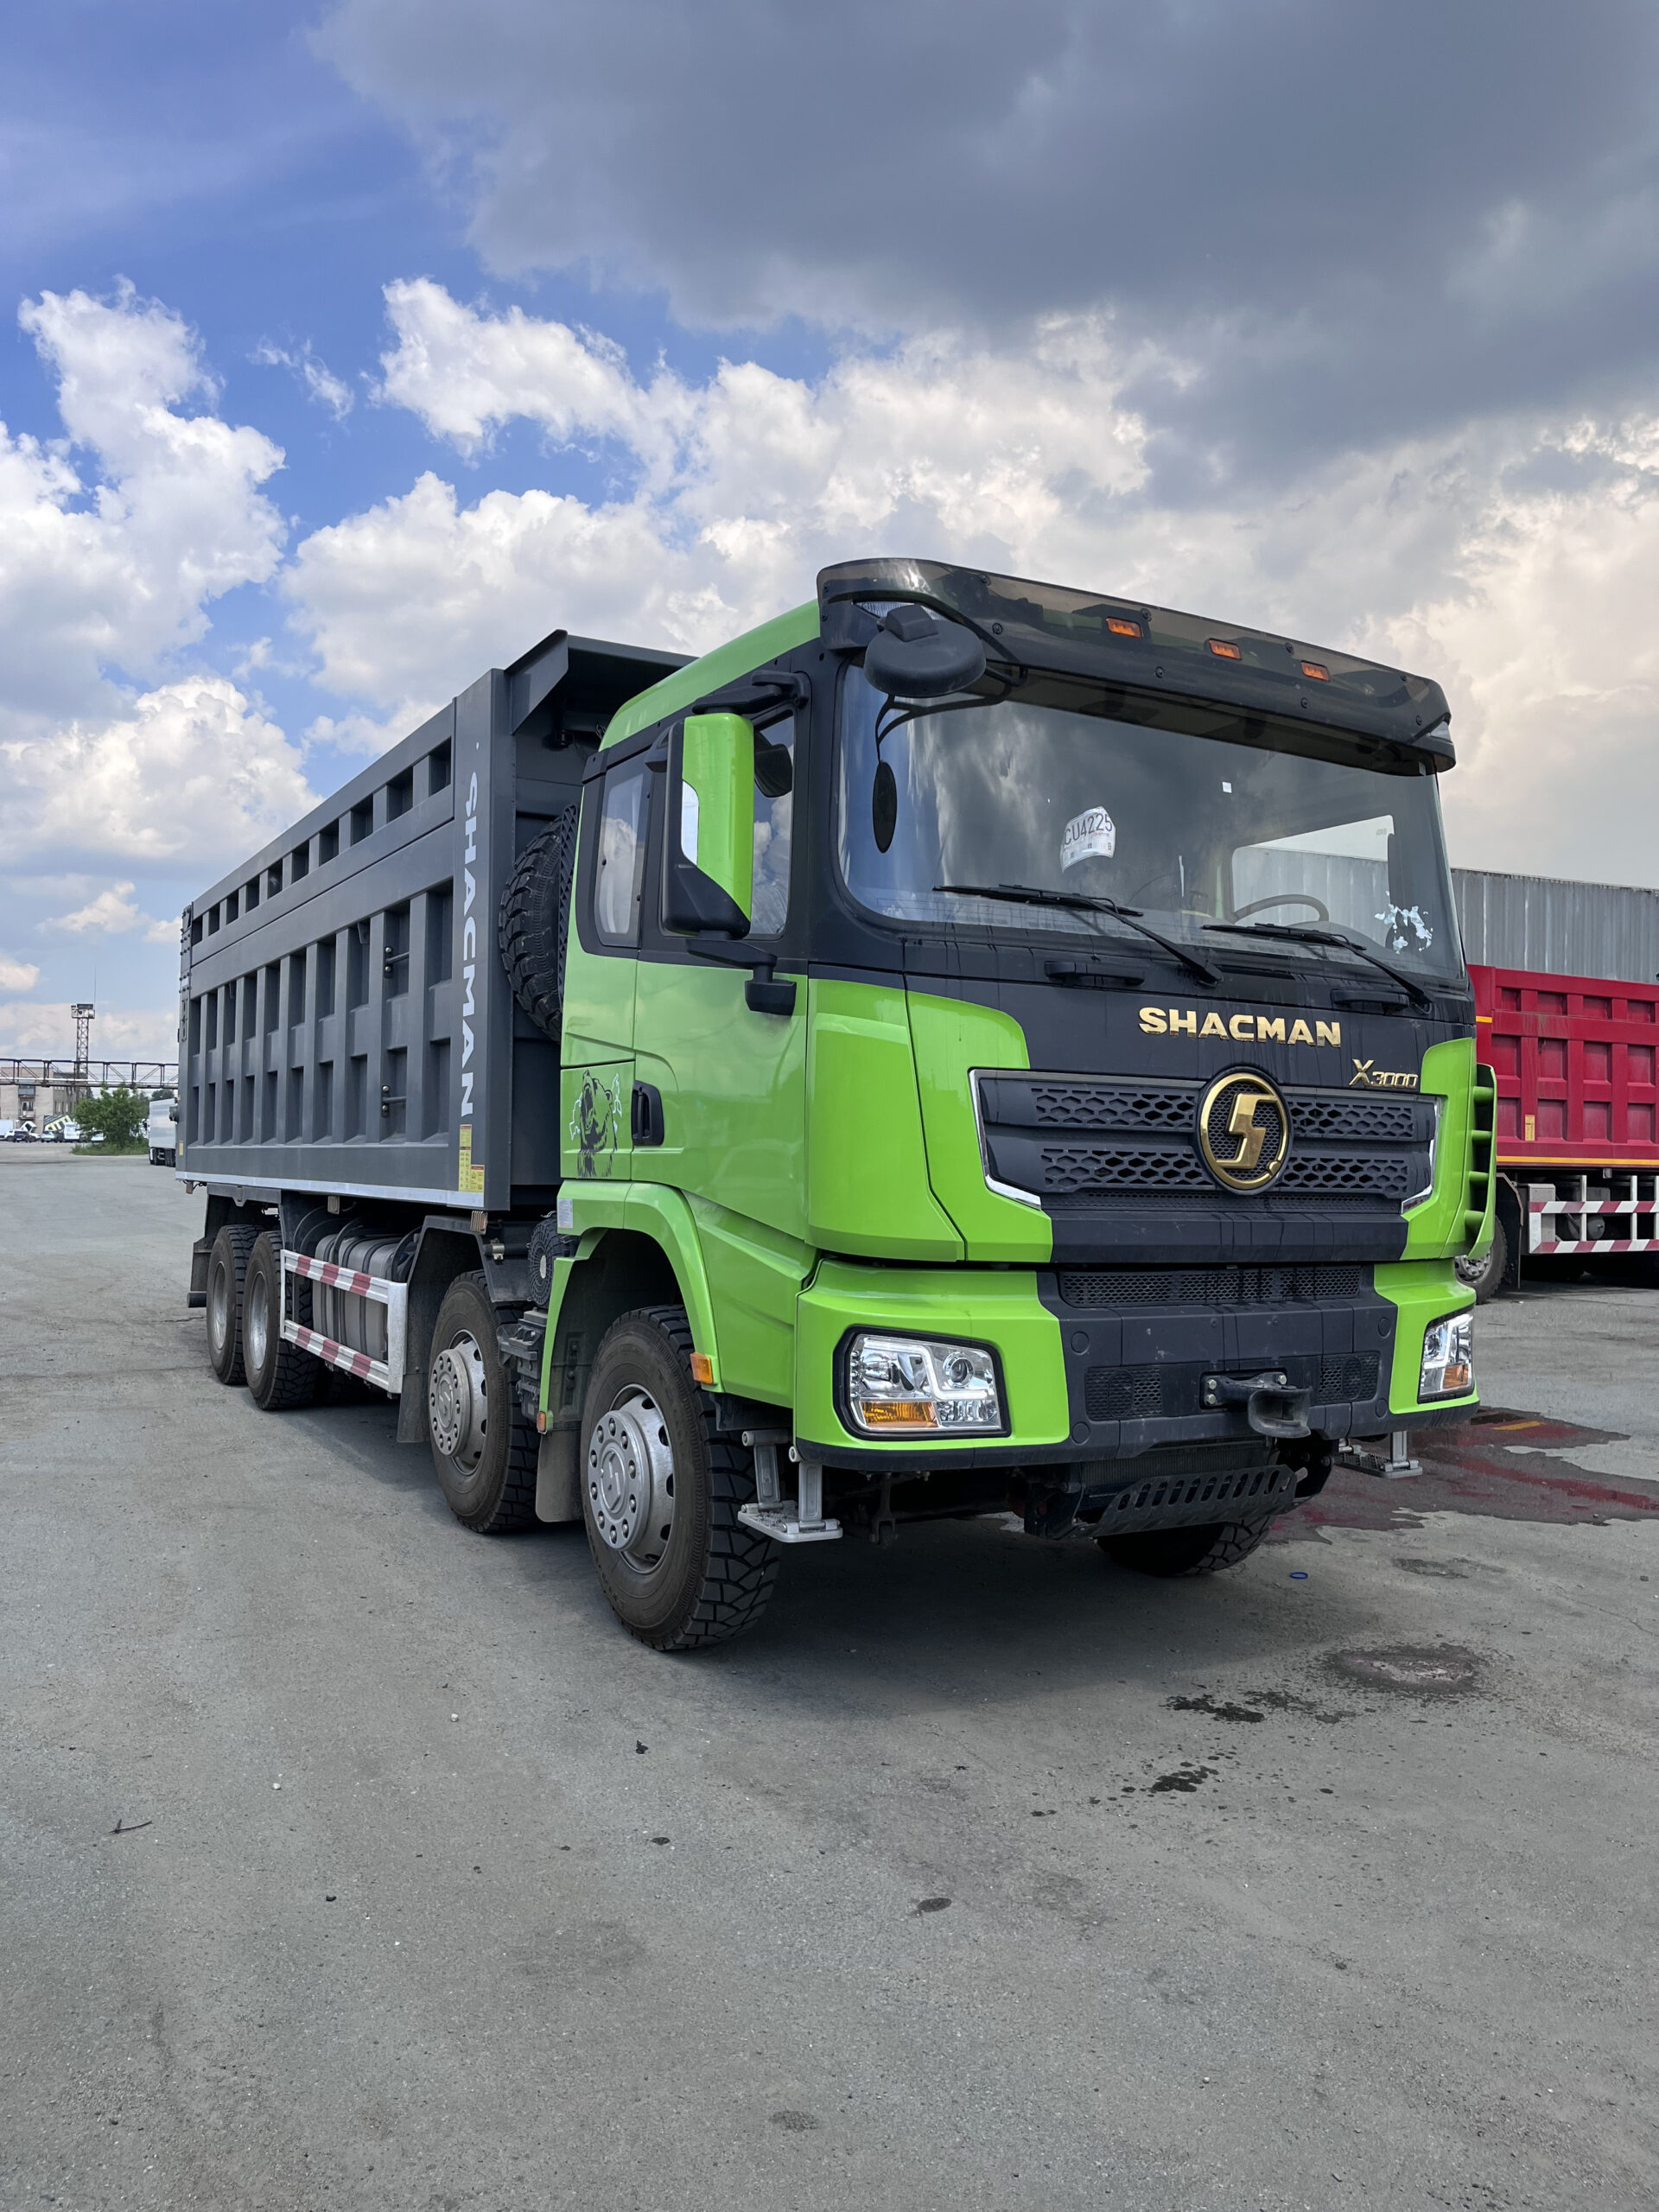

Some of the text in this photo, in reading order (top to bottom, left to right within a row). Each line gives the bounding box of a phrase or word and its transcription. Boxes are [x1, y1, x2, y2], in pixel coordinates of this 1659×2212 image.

[1064, 812, 1113, 845] CU4225
[461, 772, 478, 1118] SHACMAN
[1139, 1007, 1341, 1048] SHACMAN
[1349, 1058, 1419, 1090] X3000
